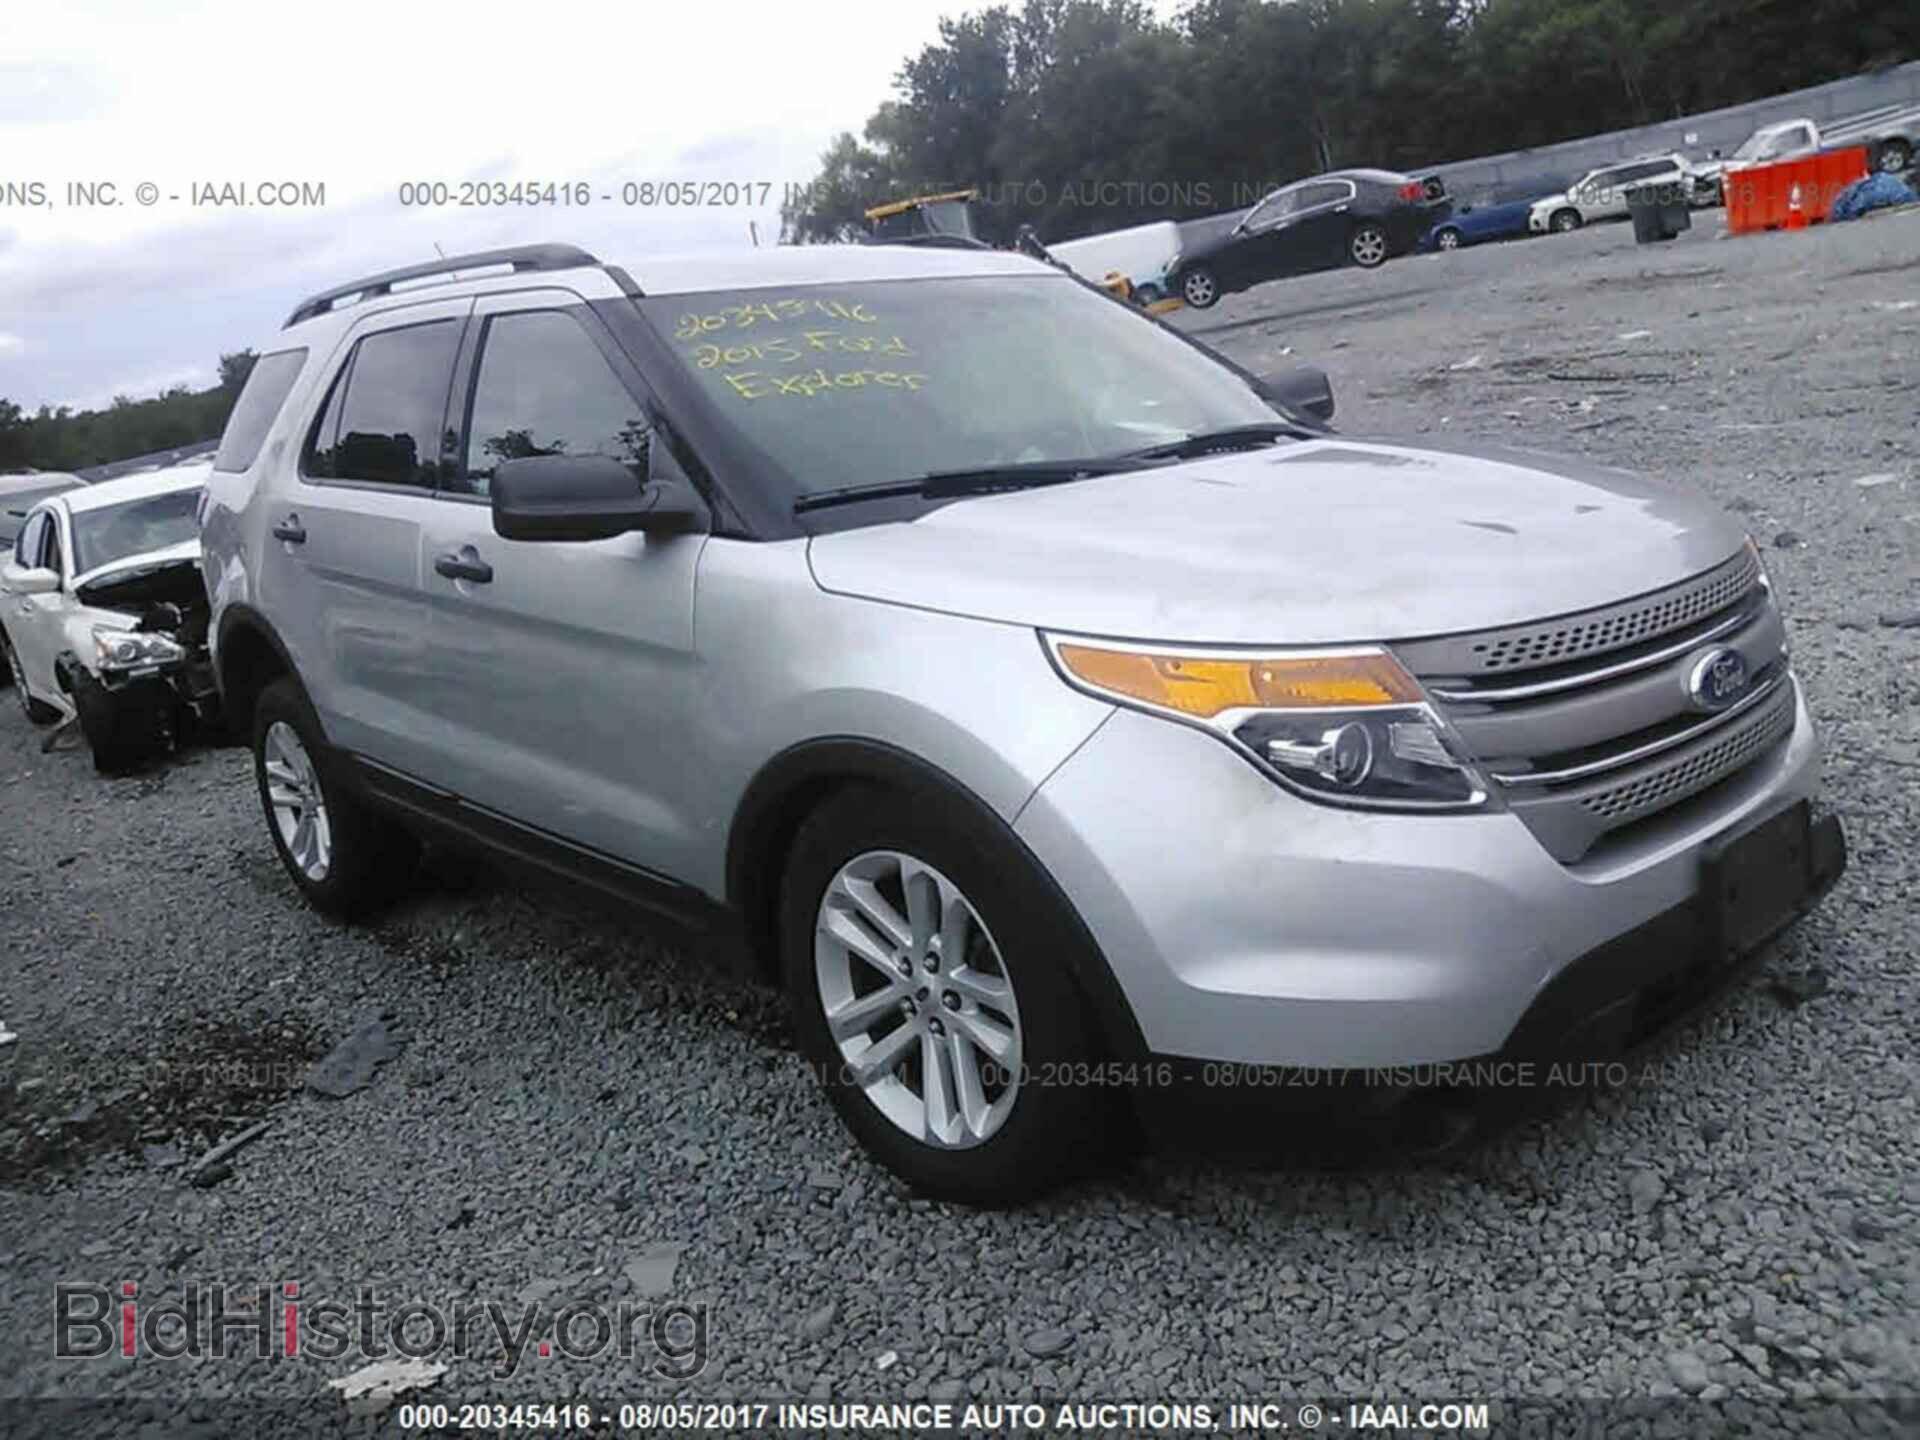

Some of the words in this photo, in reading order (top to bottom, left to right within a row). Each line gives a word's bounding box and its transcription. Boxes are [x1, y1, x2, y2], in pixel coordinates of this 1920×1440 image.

[694, 337, 802, 369] 2015
[802, 330, 918, 358] Ford
[723, 368, 930, 399] Explorer
[1712, 655, 1745, 697] Ford
